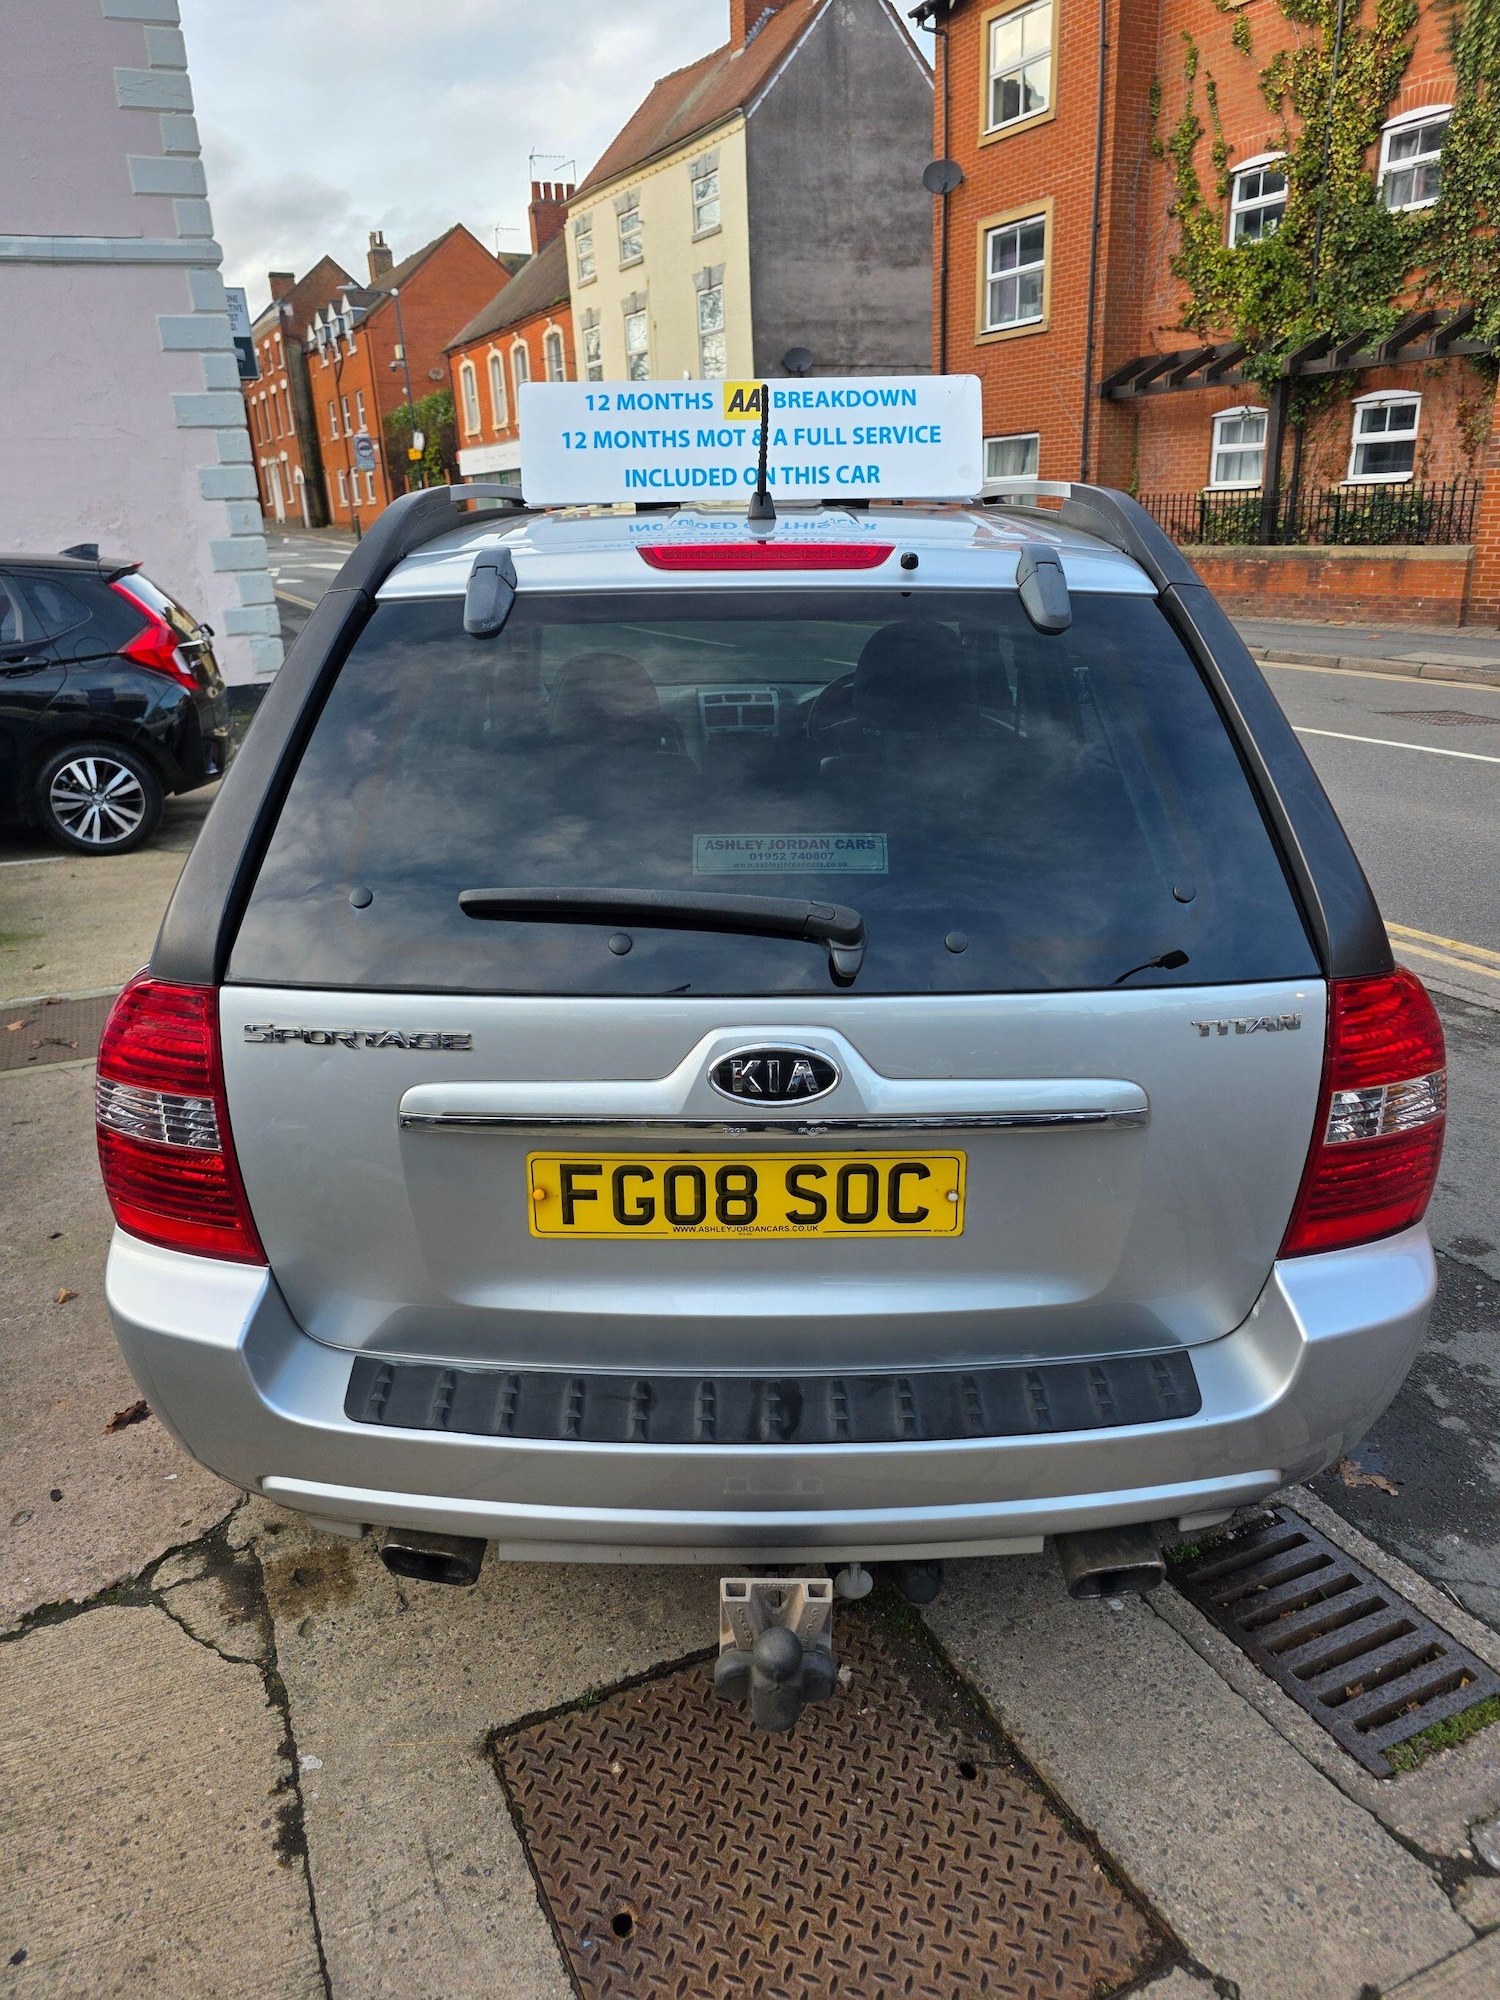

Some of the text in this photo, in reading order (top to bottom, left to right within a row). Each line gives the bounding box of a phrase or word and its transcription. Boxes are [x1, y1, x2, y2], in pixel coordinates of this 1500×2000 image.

[585, 389, 917, 413] 12 MONTHS AA BREAKDOWN
[562, 431, 587, 449] 12
[593, 430, 690, 449] MONTHS
[696, 429, 746, 447] MOT
[773, 429, 788, 446] A
[794, 427, 847, 446] FULL
[852, 425, 941, 445] SERVICE
[625, 465, 880, 488] INCLUDED ON THIS CAR
[705, 839, 876, 850] ASHLEY JORDAN CARS
[749, 852, 835, 861] 01952 740807
[733, 861, 848, 869] www.ashleyjordancars.co.uk
[243, 1023, 472, 1050] SPORTAGE
[1191, 1013, 1302, 1037] TITAN
[730, 1060, 820, 1093] KIA
[559, 1162, 931, 1226] FG08 SOC
[672, 1225, 819, 1233] WWW.ASHLEYJORDANCARS.CO.UK
